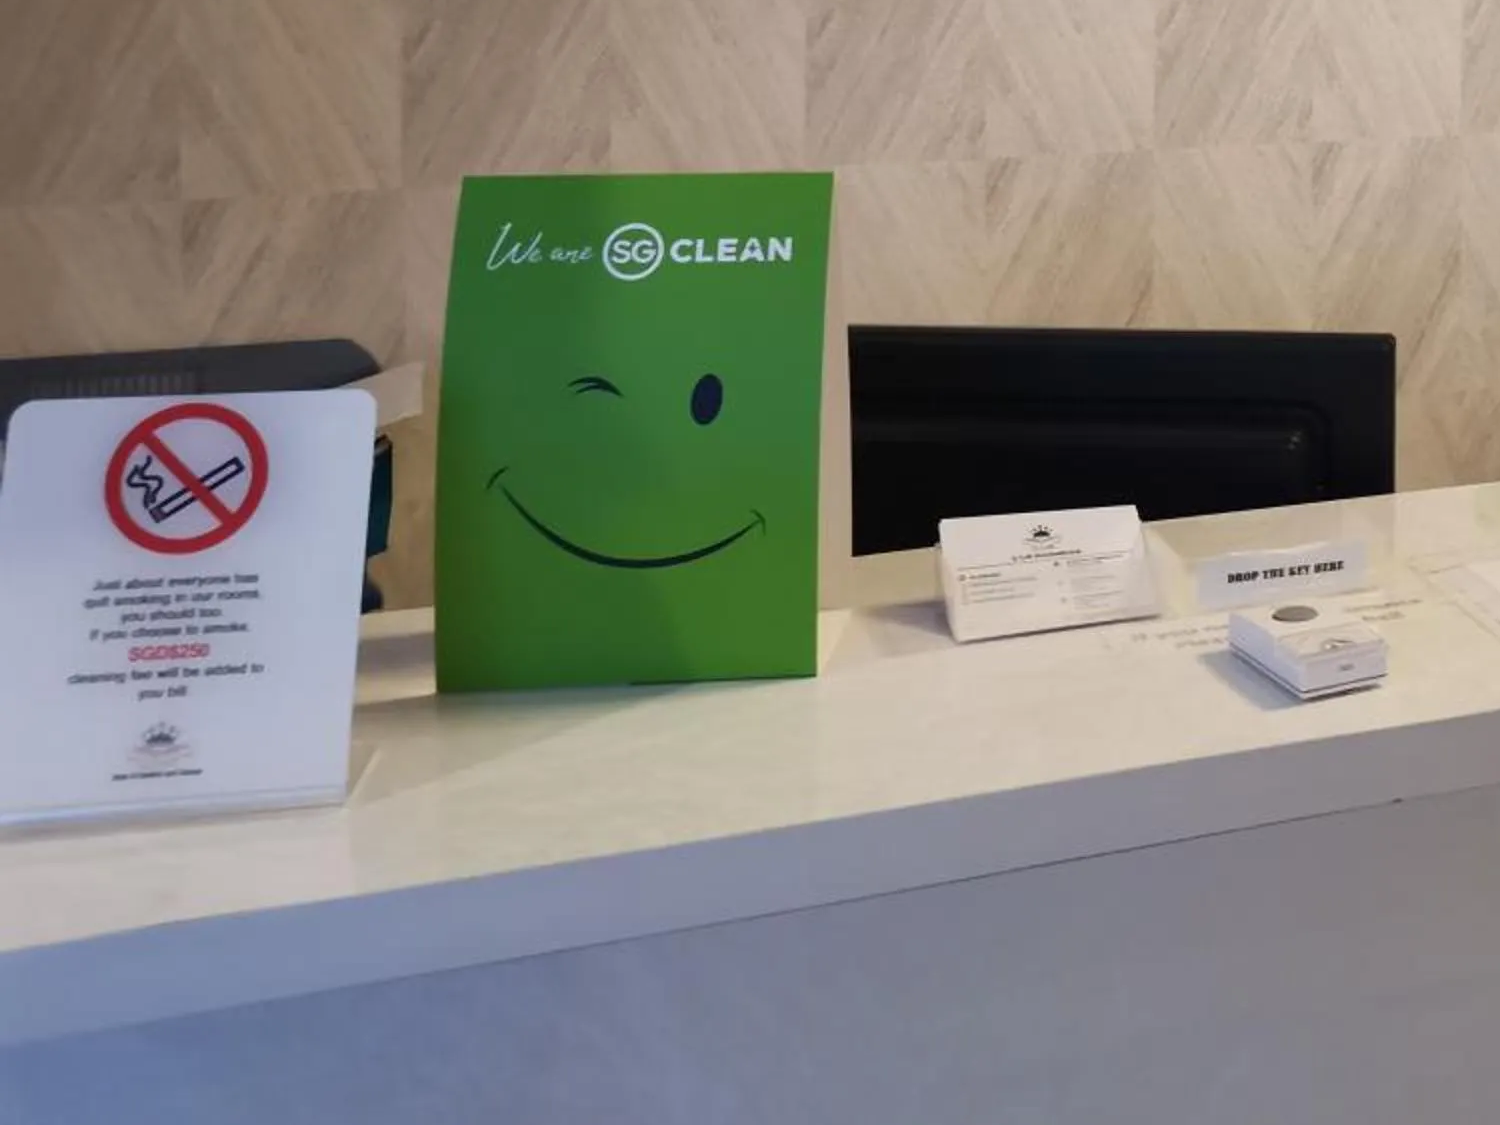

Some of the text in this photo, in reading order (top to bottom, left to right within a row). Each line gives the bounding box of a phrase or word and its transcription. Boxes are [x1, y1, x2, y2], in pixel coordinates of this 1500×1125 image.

[486, 223, 543, 270] We
[670, 237, 793, 264] CLEAN
[1227, 560, 1344, 584] DROP THE KEY HERE
[125, 578, 163, 589] about
[169, 576, 230, 588] everyone
[234, 573, 259, 583] has
[114, 594, 171, 607] smoking
[121, 613, 145, 625] you
[150, 608, 194, 621] should
[102, 630, 127, 642] you
[185, 625, 198, 635] to
[67, 673, 126, 685] cleaning
[157, 667, 179, 678] will
[182, 666, 199, 678] be
[204, 663, 247, 676] added
[251, 663, 265, 674] to
